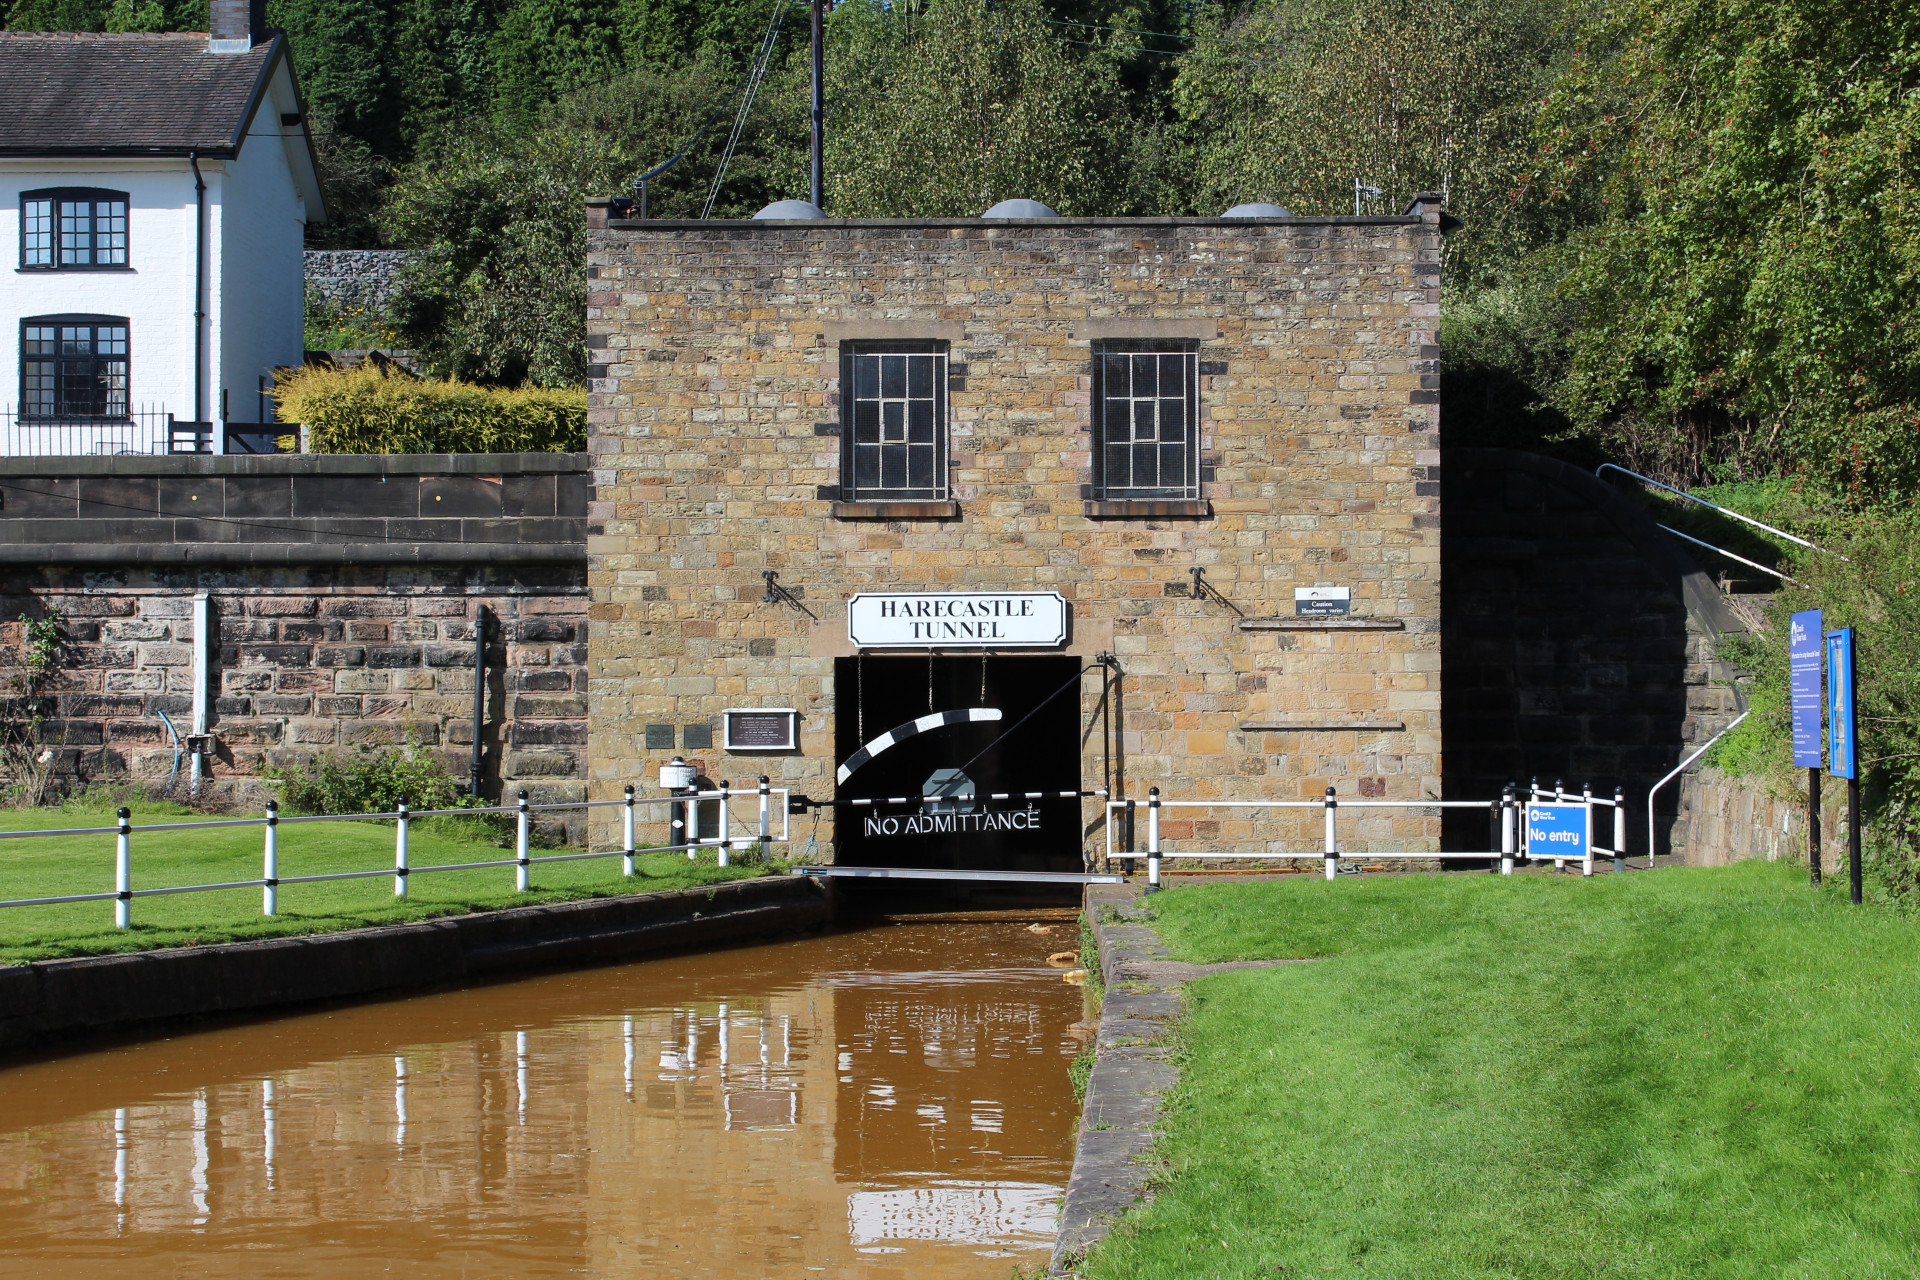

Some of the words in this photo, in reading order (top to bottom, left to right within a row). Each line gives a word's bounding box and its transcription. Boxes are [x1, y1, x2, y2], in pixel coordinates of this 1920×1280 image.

[880, 599, 1034, 617] HARECASTLE
[909, 621, 1005, 638] TUNNEL
[867, 817, 899, 836] NO
[904, 811, 1041, 834] ADMITTANCE
[1530, 828, 1546, 842] No
[1548, 830, 1580, 846] entry
